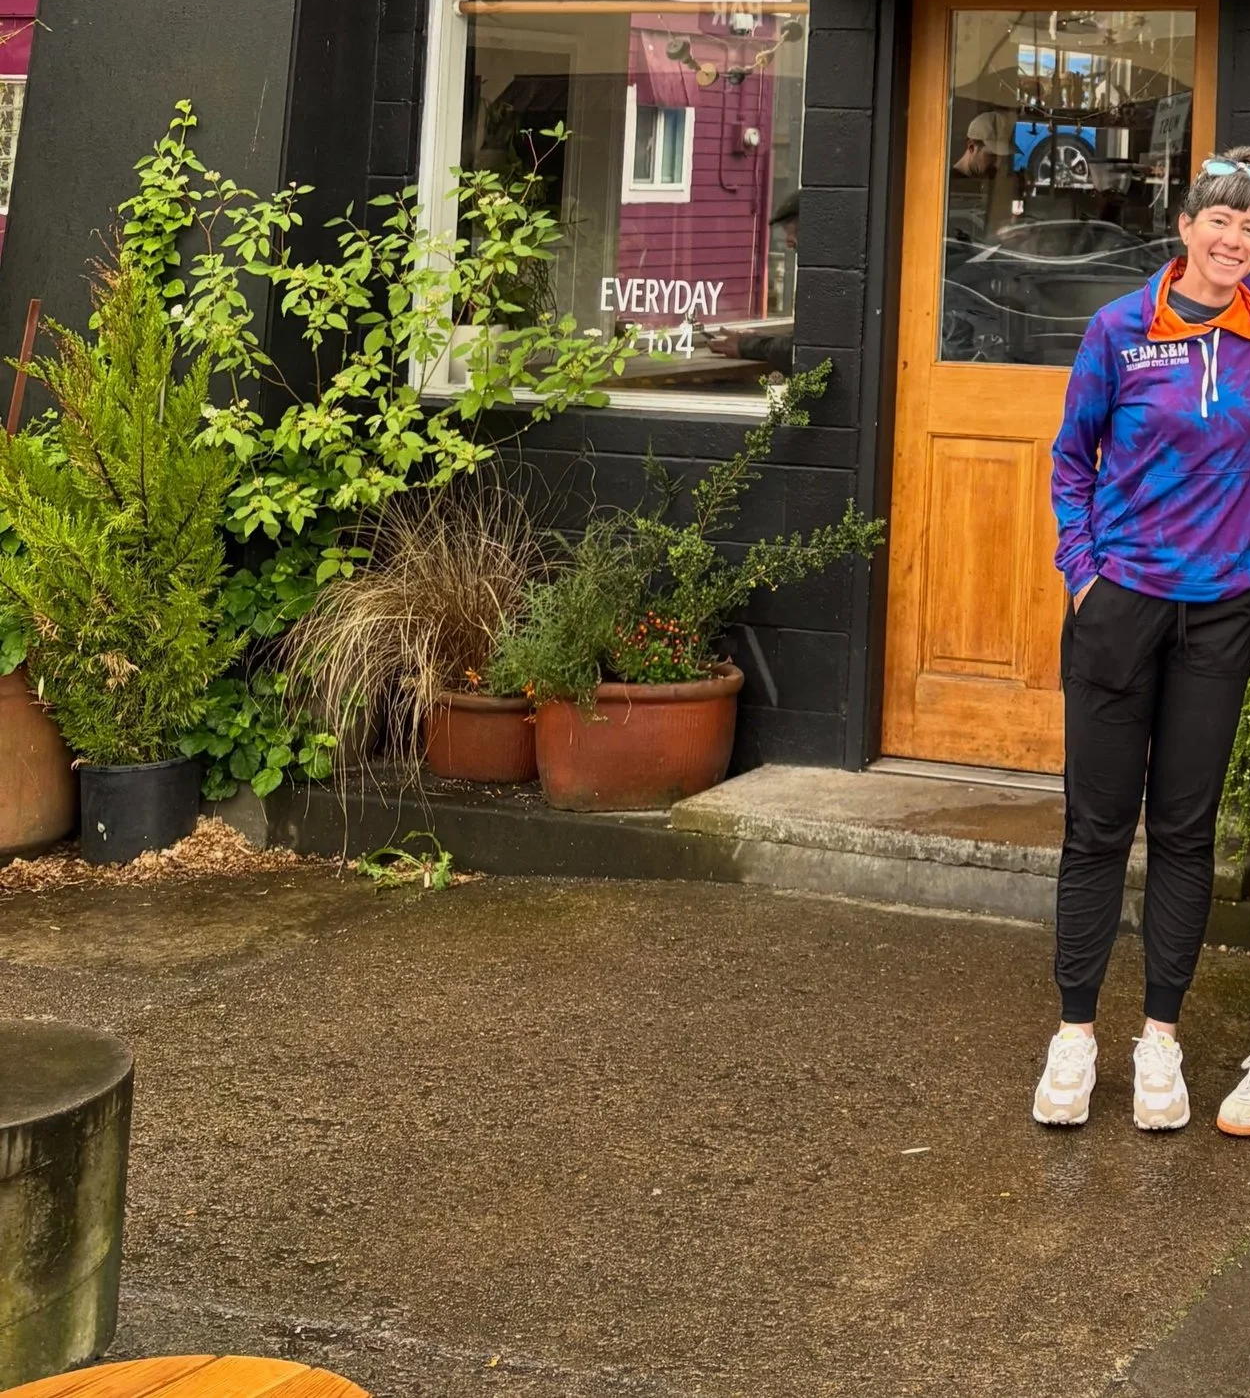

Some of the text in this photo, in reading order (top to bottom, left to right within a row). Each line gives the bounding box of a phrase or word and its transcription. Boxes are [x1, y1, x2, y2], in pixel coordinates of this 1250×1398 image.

[600, 277, 724, 316] EVERYDAY
[675, 322, 695, 359] 4
[1121, 342, 1189, 363] TEAM S&M
